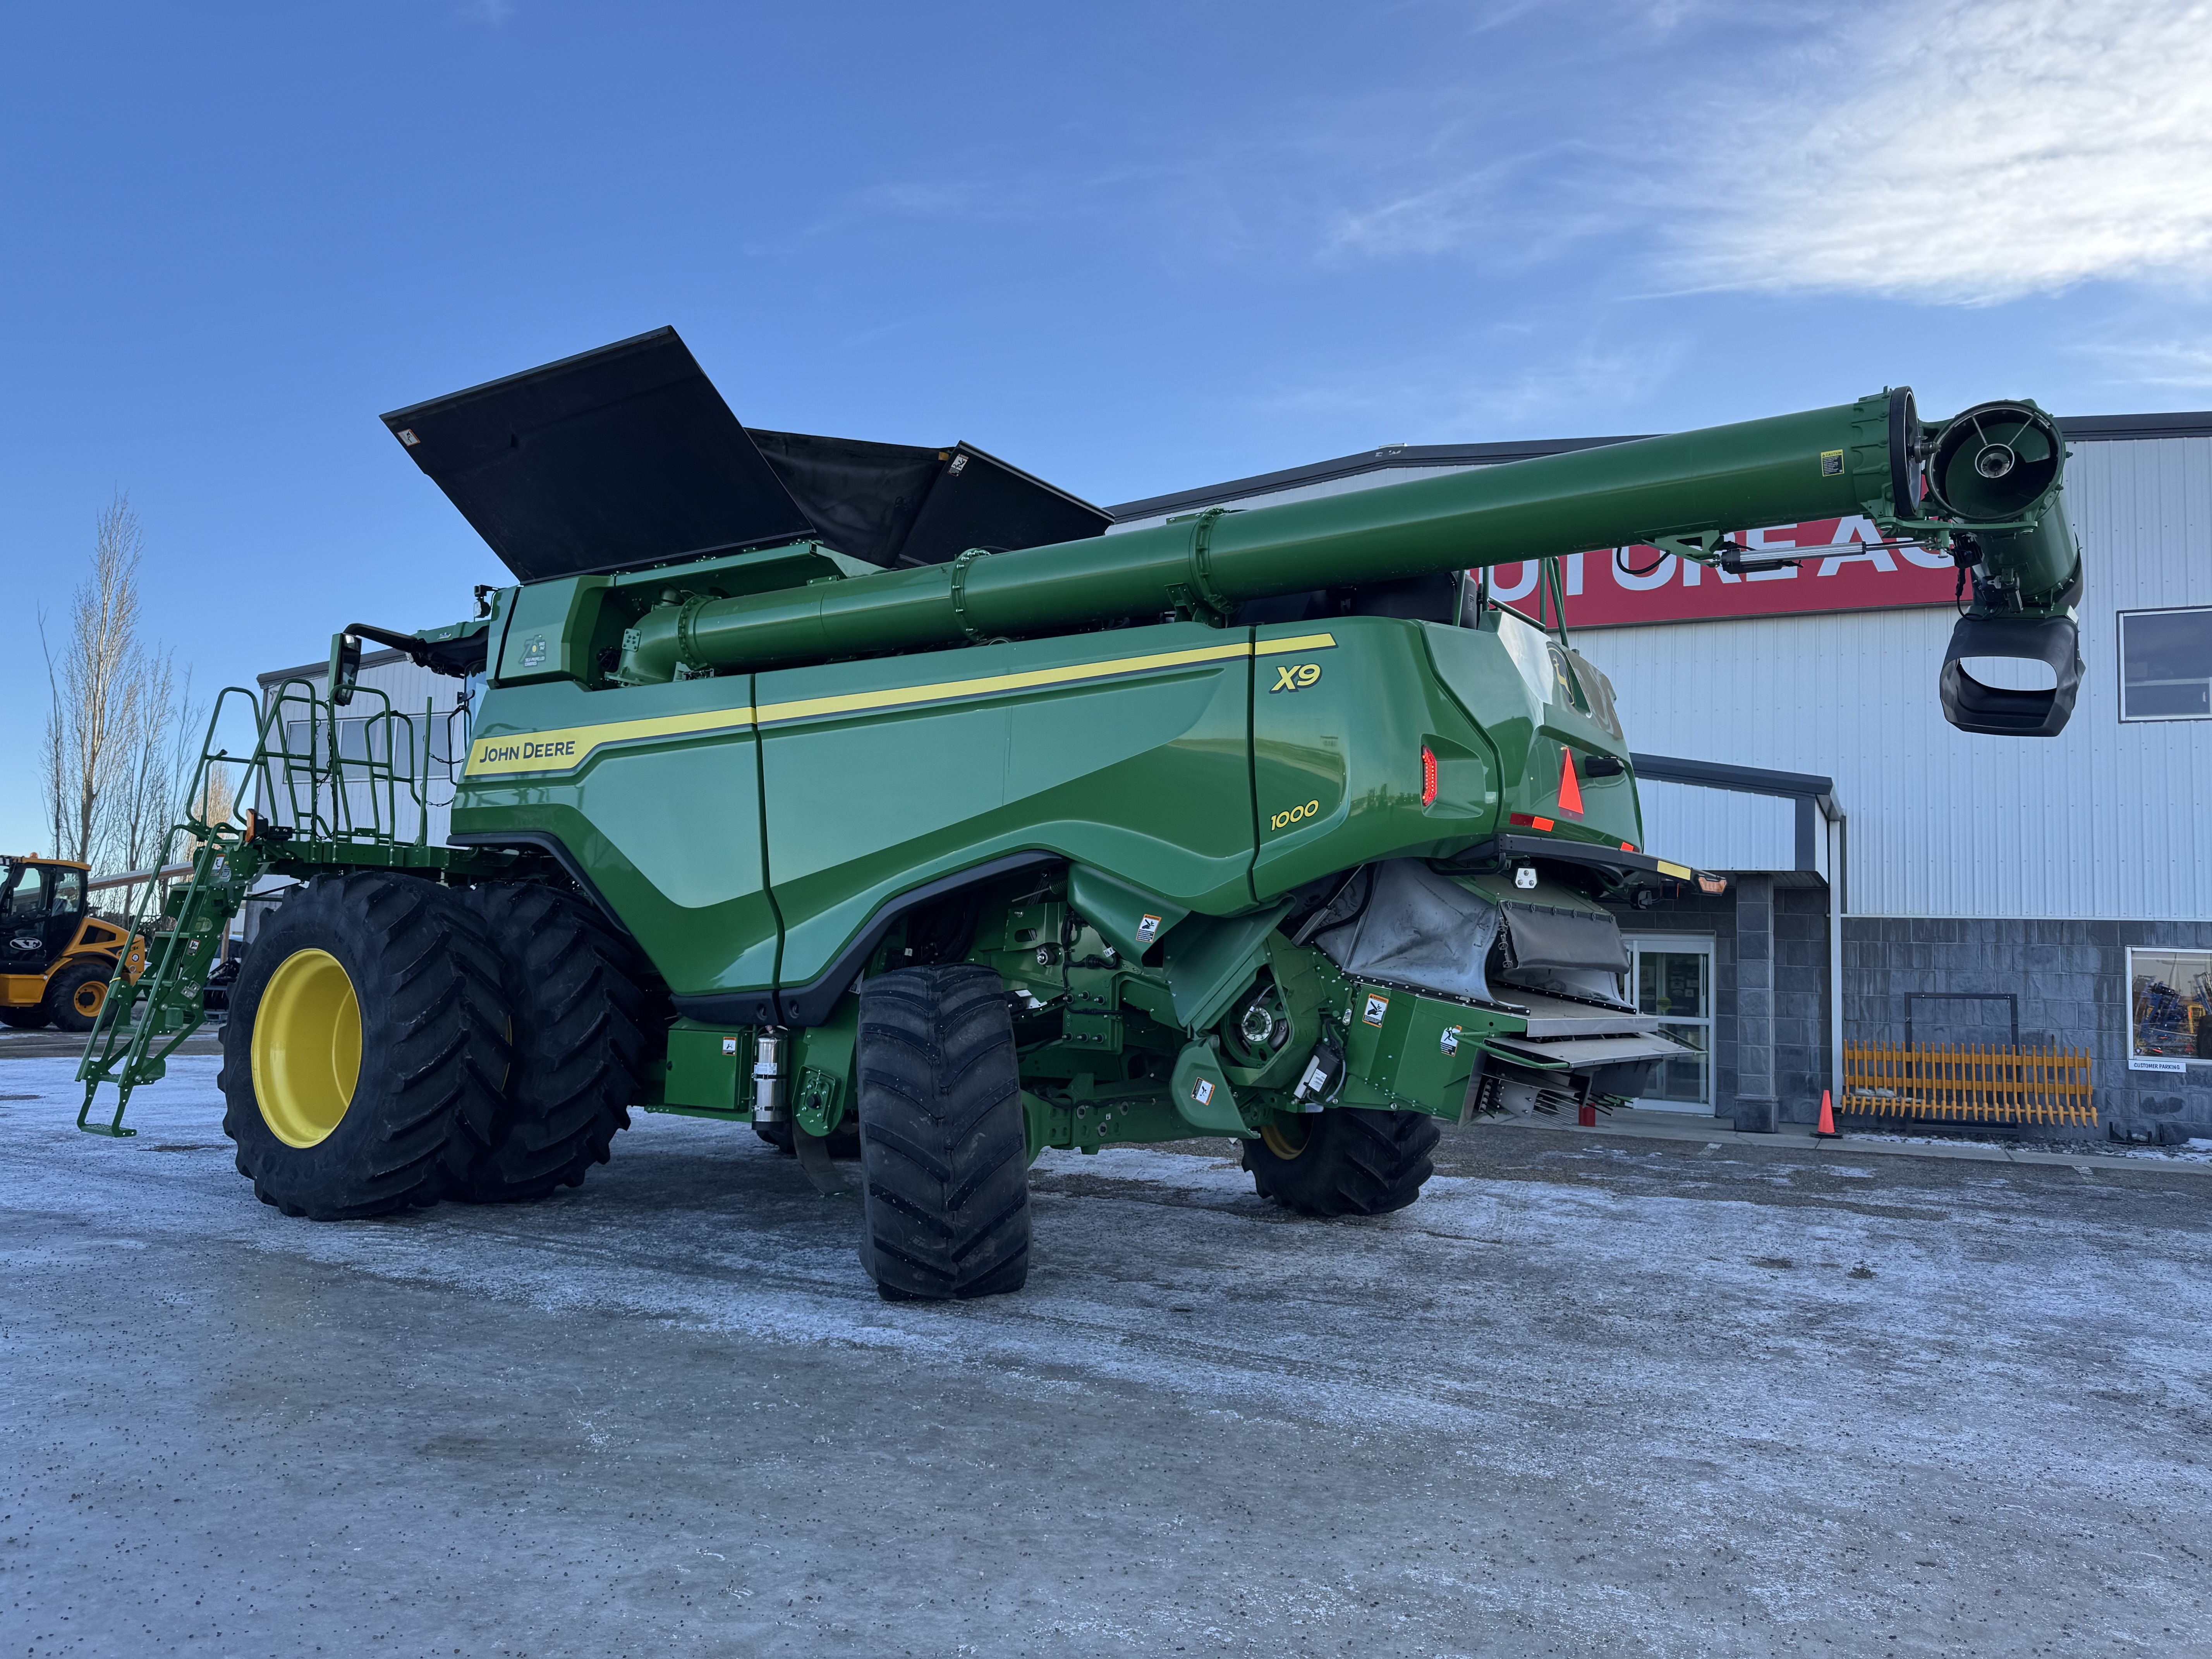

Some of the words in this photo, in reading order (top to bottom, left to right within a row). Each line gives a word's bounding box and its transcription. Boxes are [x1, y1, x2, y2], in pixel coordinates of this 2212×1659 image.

[1465, 524, 1797, 601] UURE
[1269, 663, 1322, 693] X9
[479, 746, 519, 763] JOHN
[523, 740, 575, 759] DEERE
[1270, 800, 1319, 831] 1000
